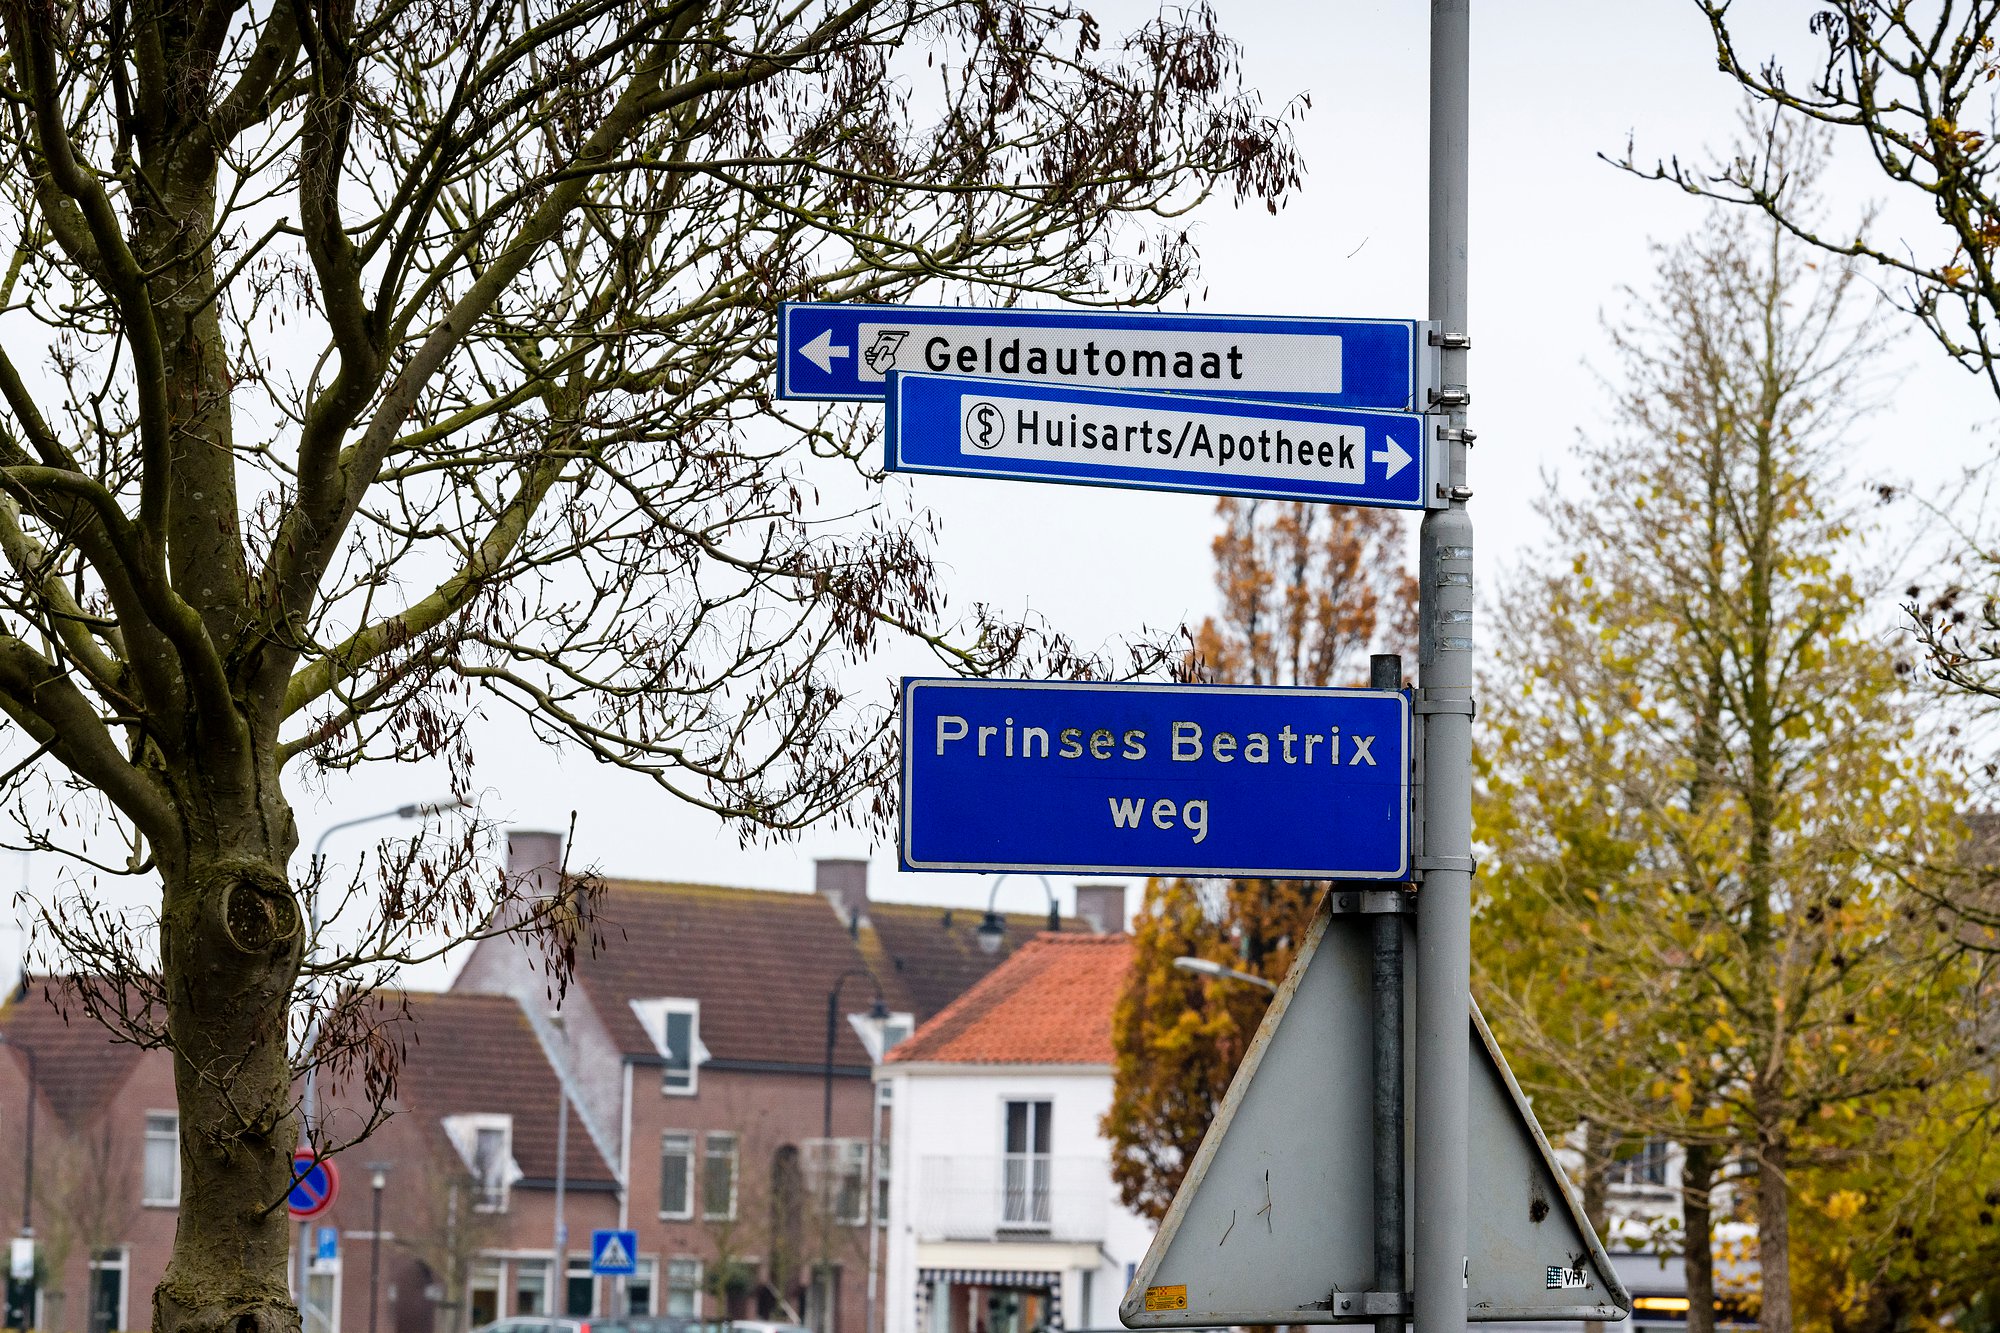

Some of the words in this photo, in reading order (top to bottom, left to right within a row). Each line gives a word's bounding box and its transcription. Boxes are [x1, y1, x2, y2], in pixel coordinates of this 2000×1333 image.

[924, 336, 1243, 380] Geldautomaat
[1017, 409, 1355, 470] Huisarts/Apotheek
[936, 715, 1147, 760] Prinses
[1172, 721, 1377, 766] Beatrix
[1108, 797, 1208, 844] weg
